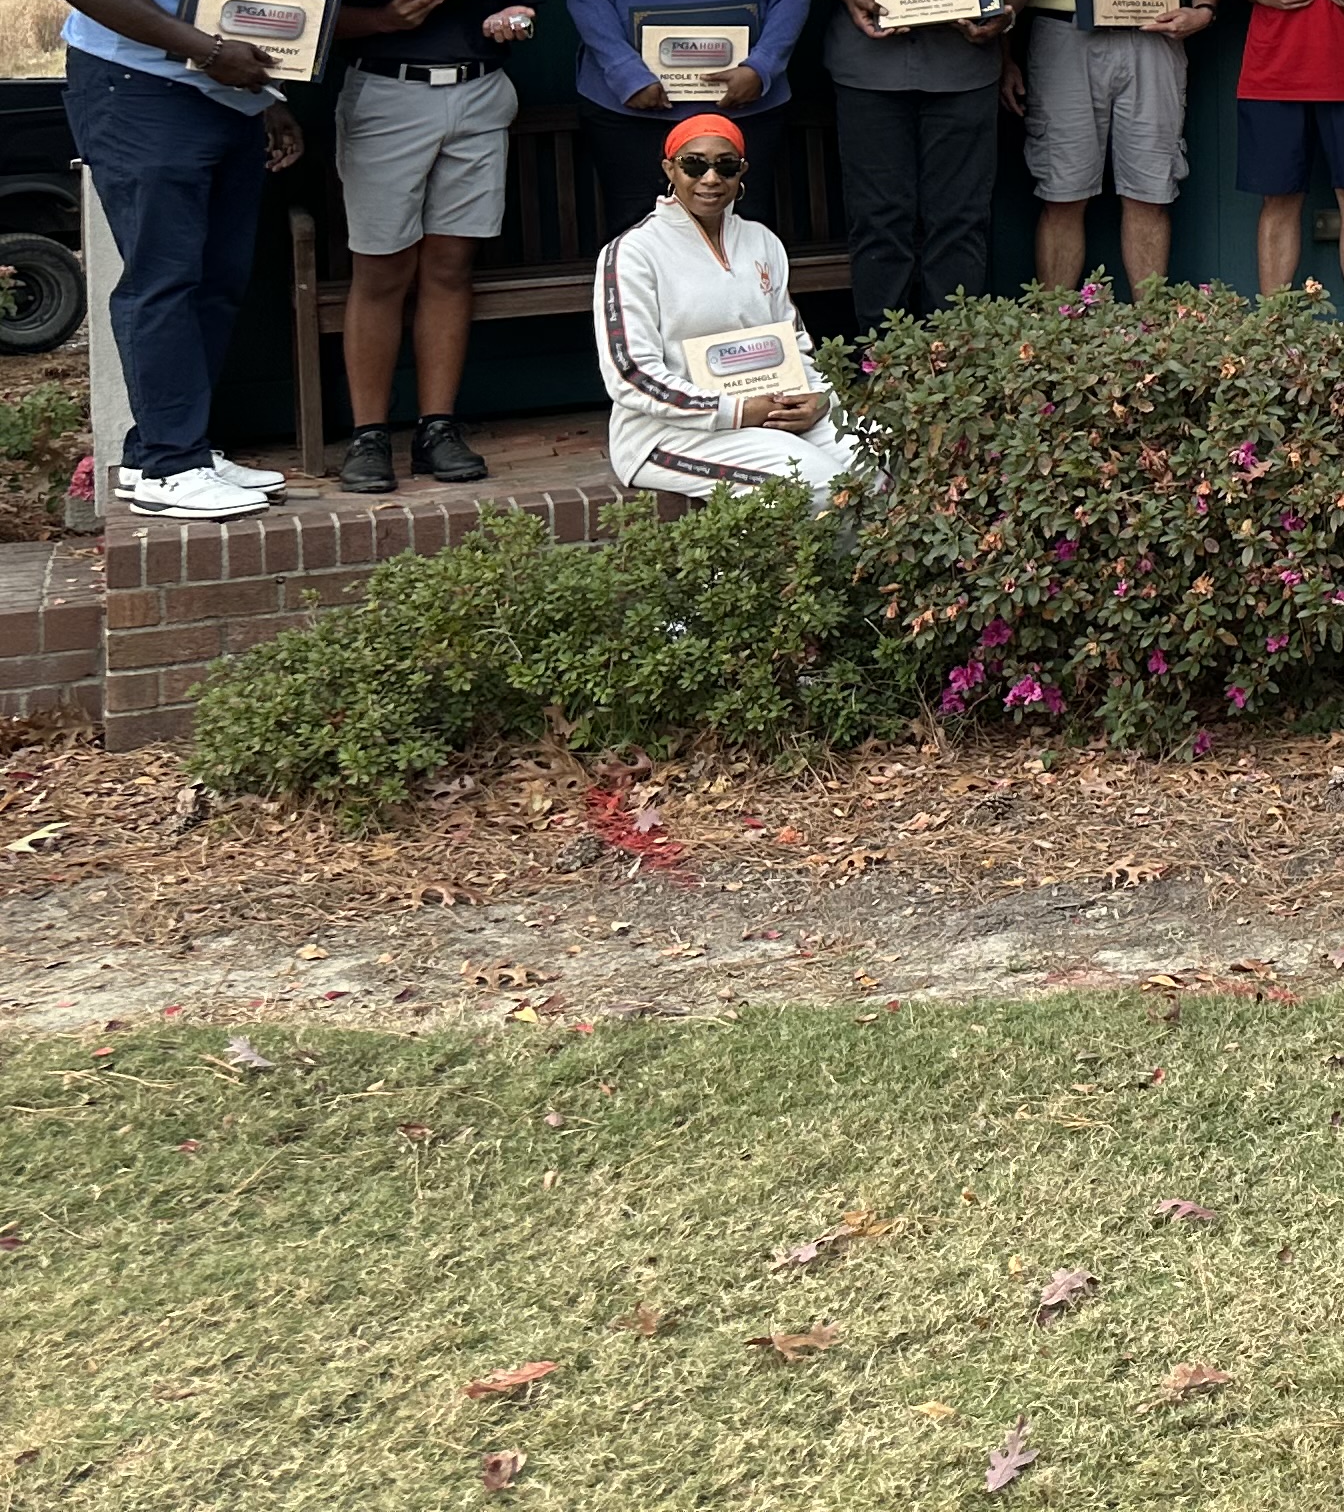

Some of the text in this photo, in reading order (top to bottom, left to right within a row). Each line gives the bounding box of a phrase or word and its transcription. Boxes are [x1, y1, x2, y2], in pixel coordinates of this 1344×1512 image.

[236, 6, 267, 17] PGA
[672, 42, 698, 50] PGA
[719, 340, 776, 356] PGA HOPE
